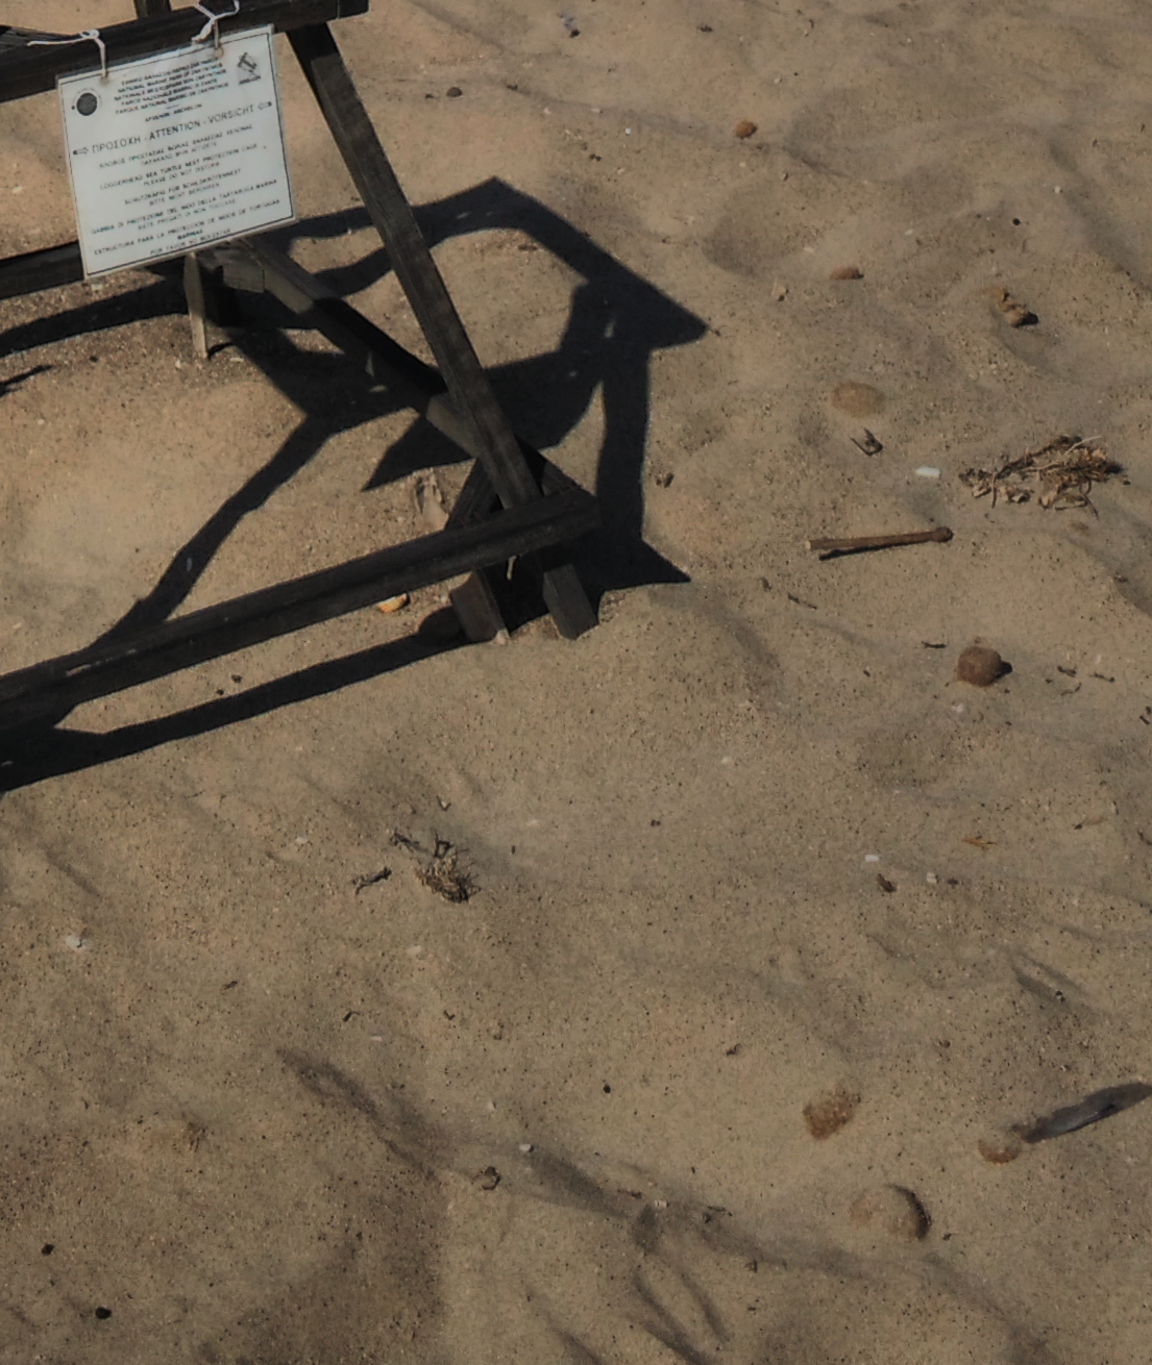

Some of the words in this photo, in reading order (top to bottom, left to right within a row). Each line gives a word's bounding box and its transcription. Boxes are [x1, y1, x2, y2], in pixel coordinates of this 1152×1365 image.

[92, 136, 141, 154] ΠΡΟΣΟΧΗ
[149, 120, 200, 141] ATTENTION
[207, 104, 253, 124] VORSICHT
